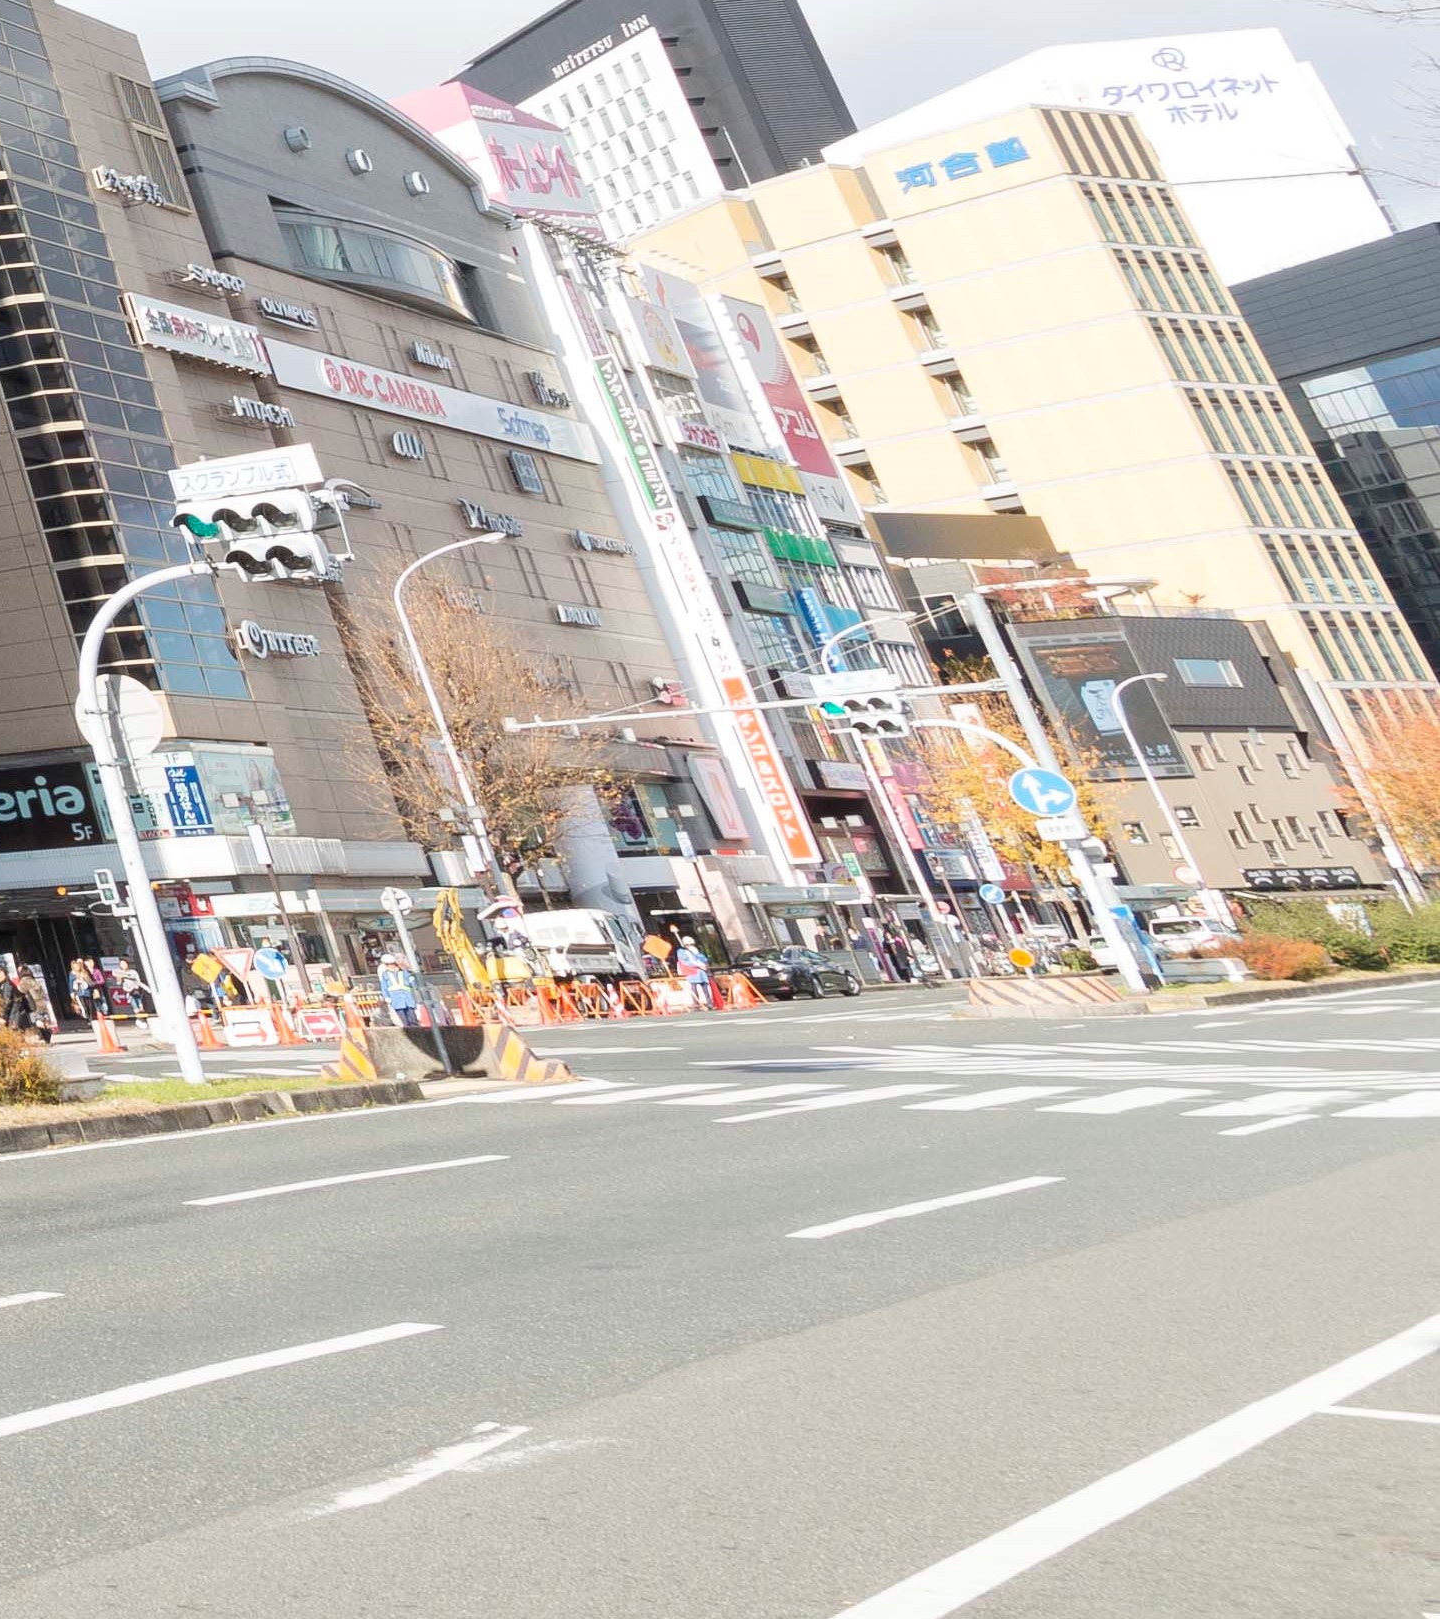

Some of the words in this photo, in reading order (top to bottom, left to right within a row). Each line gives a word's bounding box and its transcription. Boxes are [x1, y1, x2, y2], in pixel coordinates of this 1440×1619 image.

[551, 35, 613, 80] MEITETSU
[621, 14, 650, 38] INN
[1102, 72, 1281, 107] ダイワロイネット
[1169, 102, 1239, 125] ホテル
[260, 297, 317, 327] OLYMPUS
[413, 342, 451, 370] Nikon
[341, 364, 374, 398] BIC
[374, 374, 448, 417] CAMERA
[231, 396, 297, 427] HITACHI
[177, 456, 293, 494] スクランブル式
[72, 823, 93, 841] 5F
